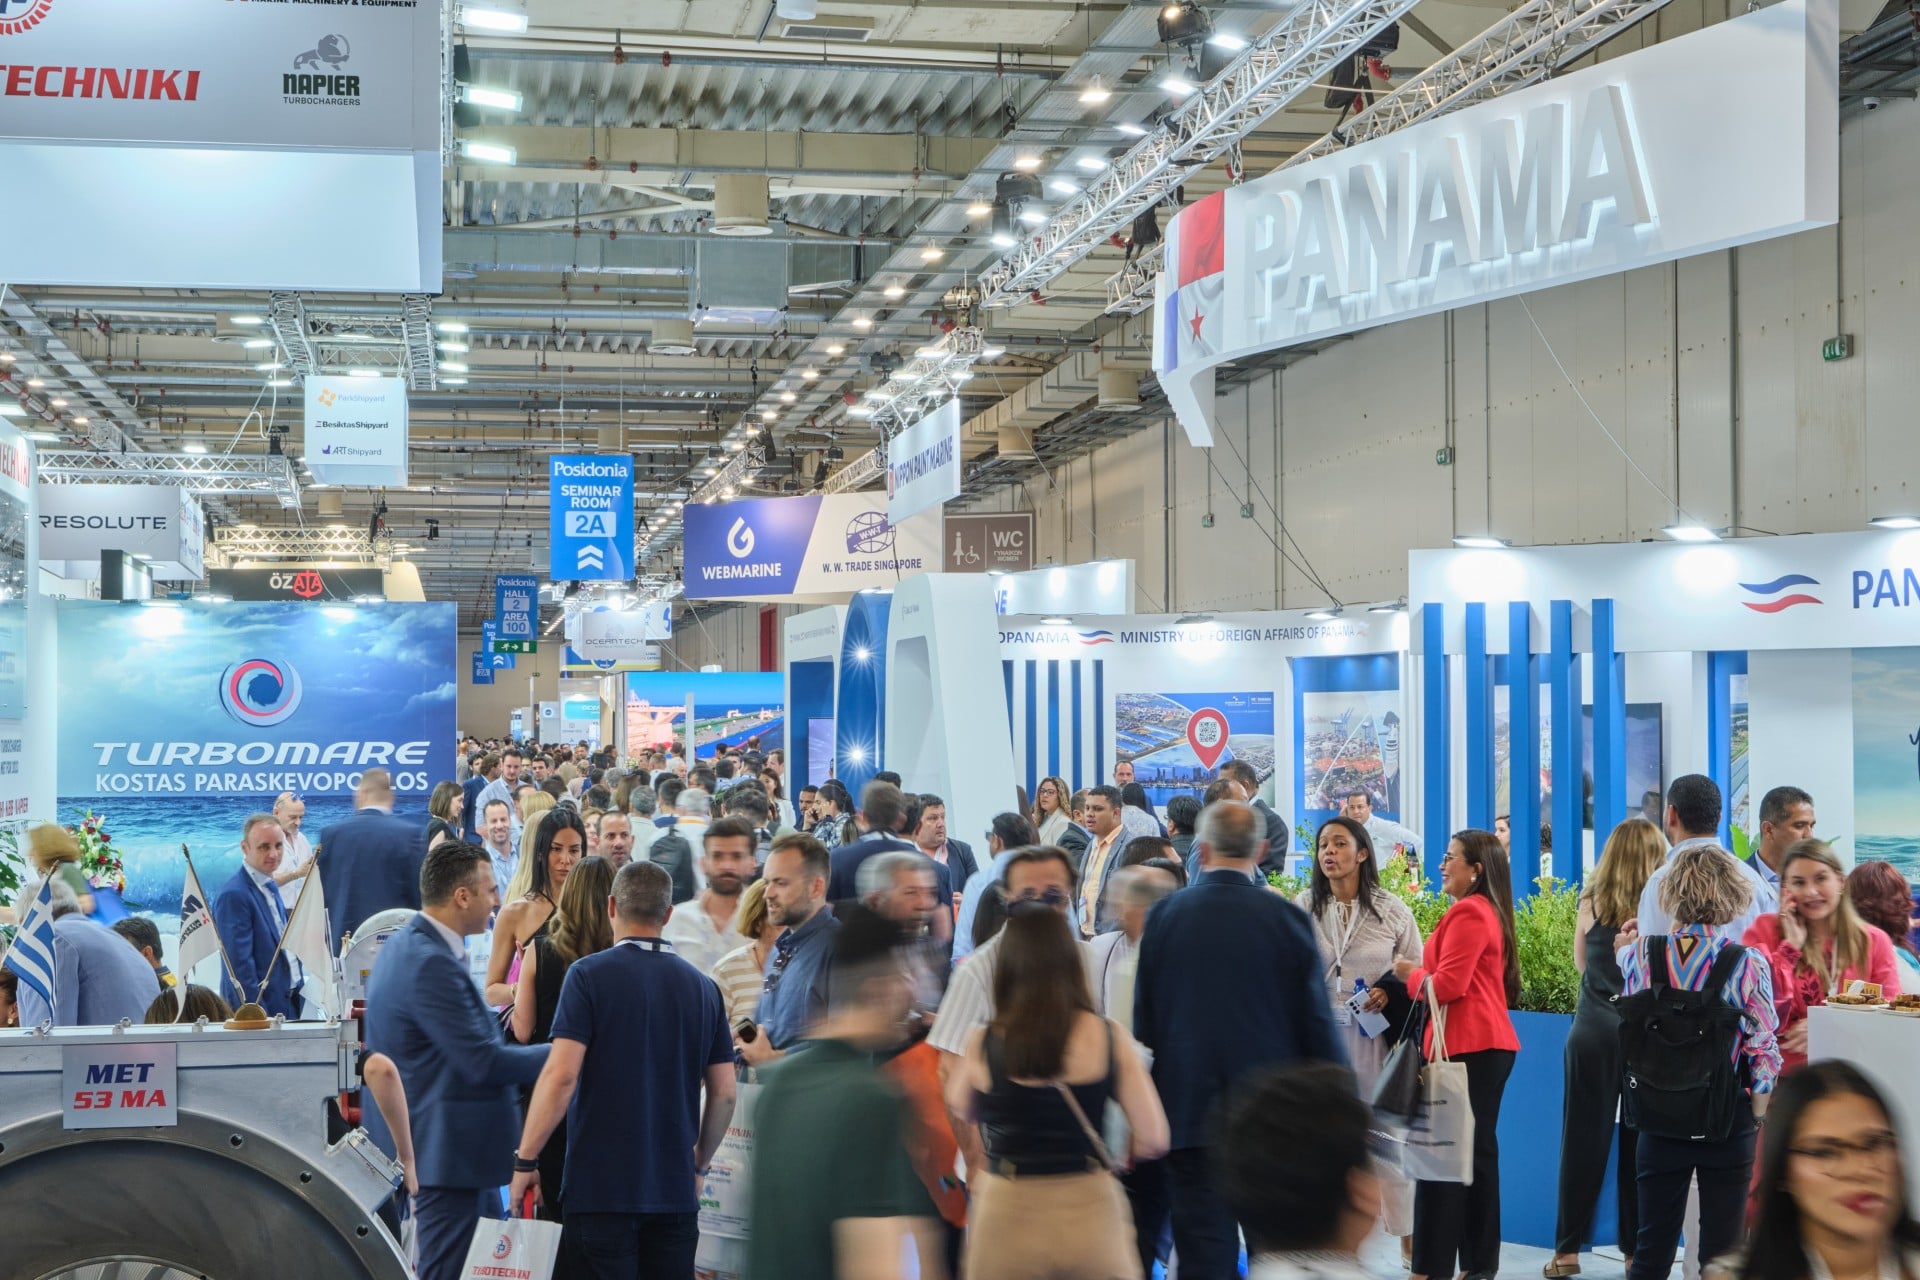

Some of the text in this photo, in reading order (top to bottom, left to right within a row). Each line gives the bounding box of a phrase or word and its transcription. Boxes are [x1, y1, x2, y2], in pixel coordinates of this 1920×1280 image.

[362, 0, 417, 8] EQUIPMENT
[0, 65, 200, 101] ECHNIKI
[283, 73, 360, 96] NAPIER
[283, 96, 361, 106] TURBOCHARGERS
[1245, 85, 1652, 320] PANAMA
[554, 461, 628, 477] Posidonia
[561, 485, 622, 497] SEMINAR
[571, 497, 611, 508] ROOM
[39, 515, 167, 530] RESOLUTE
[575, 515, 606, 534] 2A
[992, 530, 1024, 548] WC
[702, 562, 782, 580] WEBMARINE
[823, 558, 922, 573] W. W. TRADE SINGAPORE
[497, 578, 536, 587] Posidonia
[504, 590, 528, 598] HALL
[512, 600, 520, 609] 2
[504, 613, 528, 621] AREA
[506, 622, 526, 632] 100
[1120, 631, 1184, 644] MINISTRY
[1210, 629, 1261, 642] FOREIGN
[1264, 627, 1305, 641] AFFAIRS
[1307, 627, 1319, 639] OF
[1321, 625, 1354, 638] PANAMA
[93, 741, 431, 766] TURBOMARE
[96, 771, 428, 793] KOSTAS PARASKEVOPOLOS
[85, 1063, 154, 1084] MET
[73, 1089, 167, 1110] 53 MA
